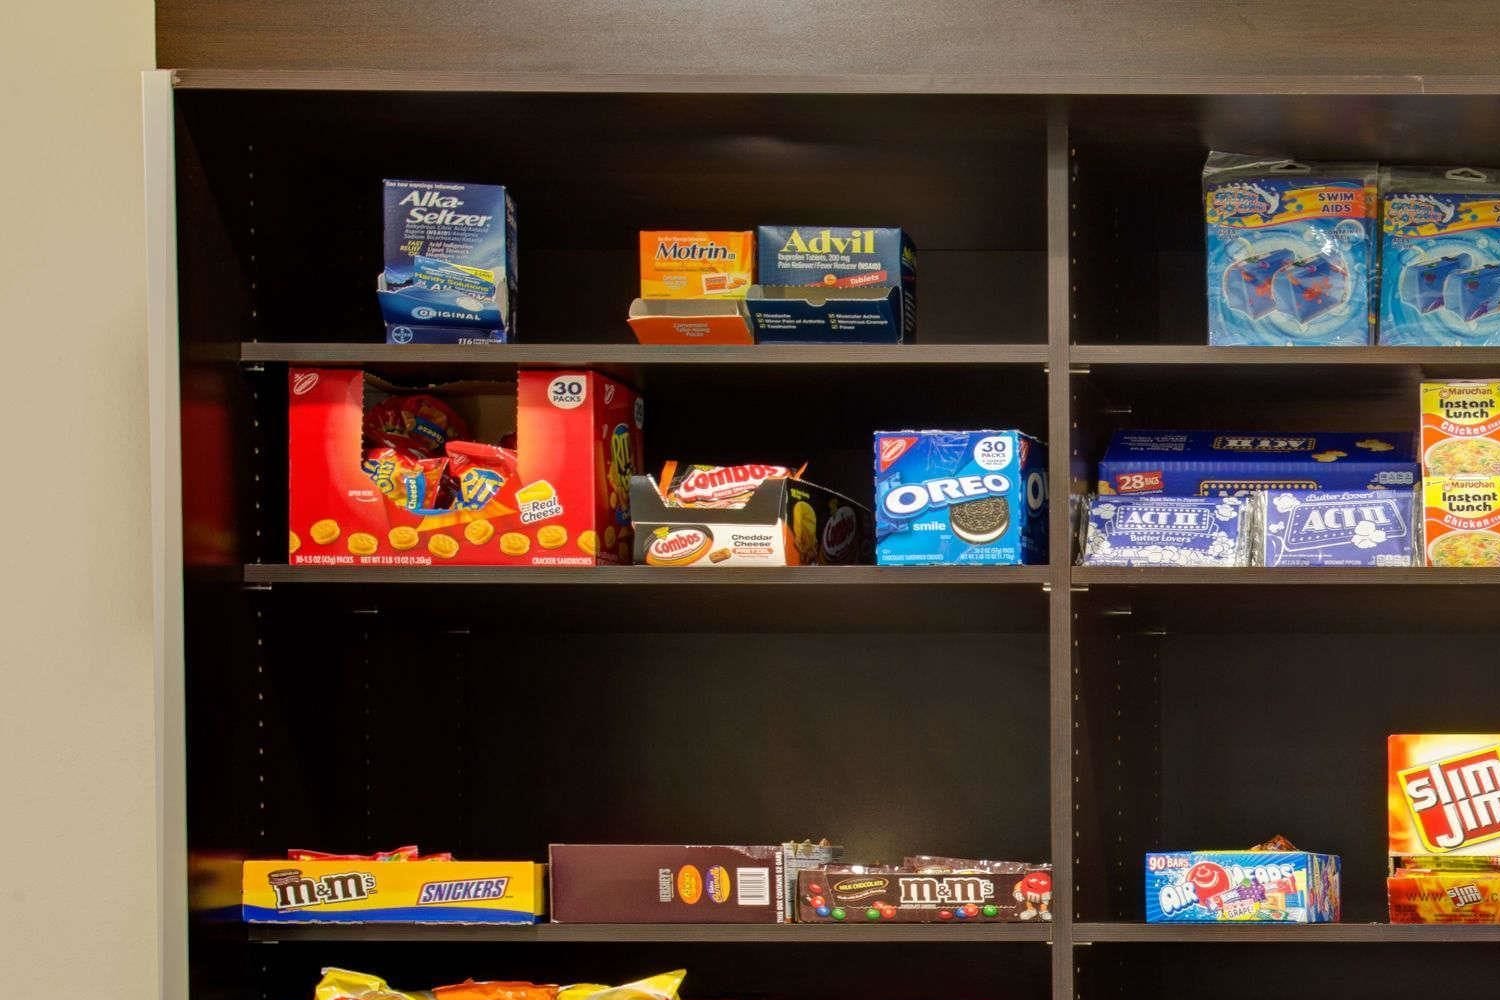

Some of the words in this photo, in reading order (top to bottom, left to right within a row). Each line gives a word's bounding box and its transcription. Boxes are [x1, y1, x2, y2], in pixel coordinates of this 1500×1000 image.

[399, 190, 464, 208] Alka-
[1319, 193, 1354, 201] SWIM
[406, 207, 493, 227] Seltzer
[779, 229, 879, 254] Advil
[655, 242, 727, 262] Motrin
[850, 274, 879, 285] Tablets
[419, 307, 482, 320] ORIGINAL
[552, 381, 582, 395] 30
[1448, 387, 1492, 396] Maruchan
[553, 395, 582, 403] PACKS
[1439, 399, 1495, 409] Instant
[1446, 409, 1489, 419] Lunch
[1441, 420, 1487, 436] Chicken
[982, 441, 1006, 452] 30
[1119, 475, 1143, 489] 28
[885, 474, 1011, 514] OREO
[532, 497, 557, 512] Real
[522, 505, 561, 522] Cheese
[1126, 510, 1171, 526] ACT
[1174, 510, 1199, 526] II
[1302, 508, 1357, 533] ACT
[1360, 506, 1391, 524] II
[913, 521, 947, 531] smile
[654, 532, 701, 555] Combos
[1130, 534, 1160, 543] Butter
[1161, 535, 1192, 544] Lovers
[1149, 856, 1166, 870] 90
[1167, 858, 1189, 867] BARS
[422, 880, 505, 903] SNICKERS
[659, 868, 672, 902] HERSHEY'S
[900, 878, 994, 903] m&m's
[1160, 882, 1199, 916] AIR
